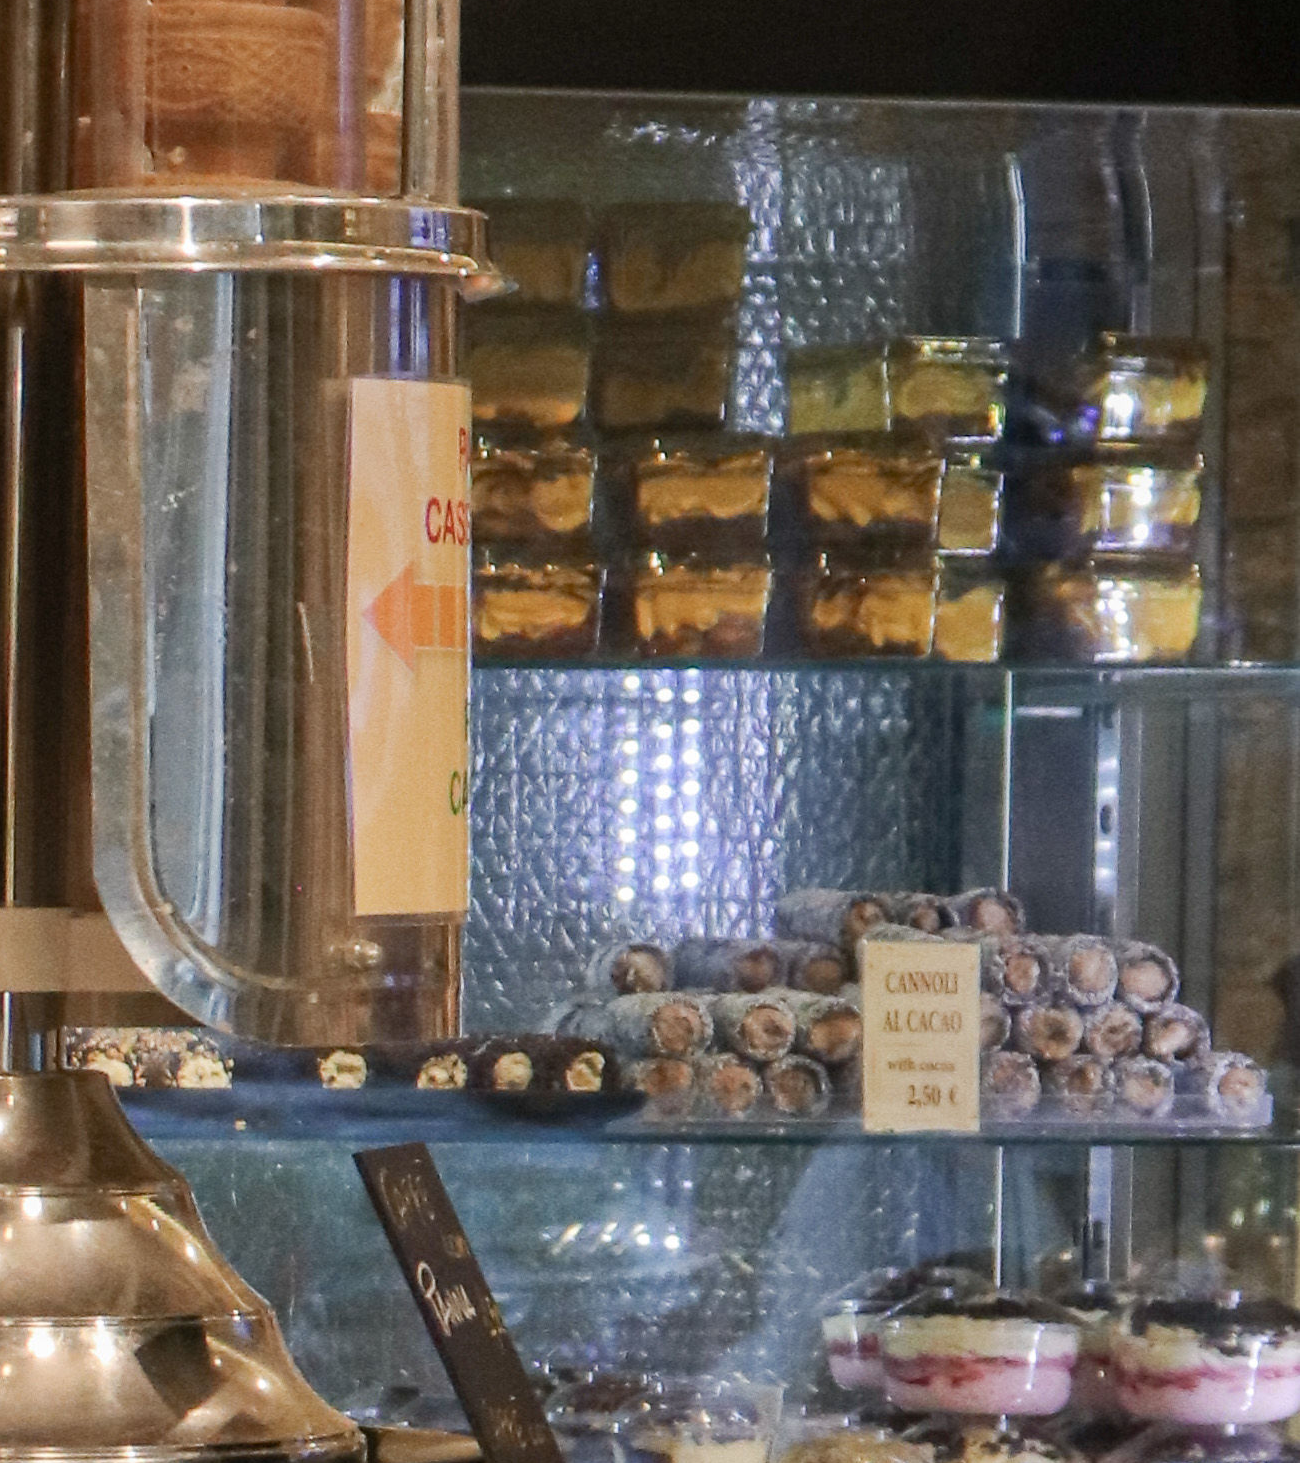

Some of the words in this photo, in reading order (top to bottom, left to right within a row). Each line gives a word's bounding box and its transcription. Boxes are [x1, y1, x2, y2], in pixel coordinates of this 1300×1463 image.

[884, 970, 959, 994] CANNOLI
[883, 1009, 903, 1033] AL
[906, 1009, 963, 1033] CACAO
